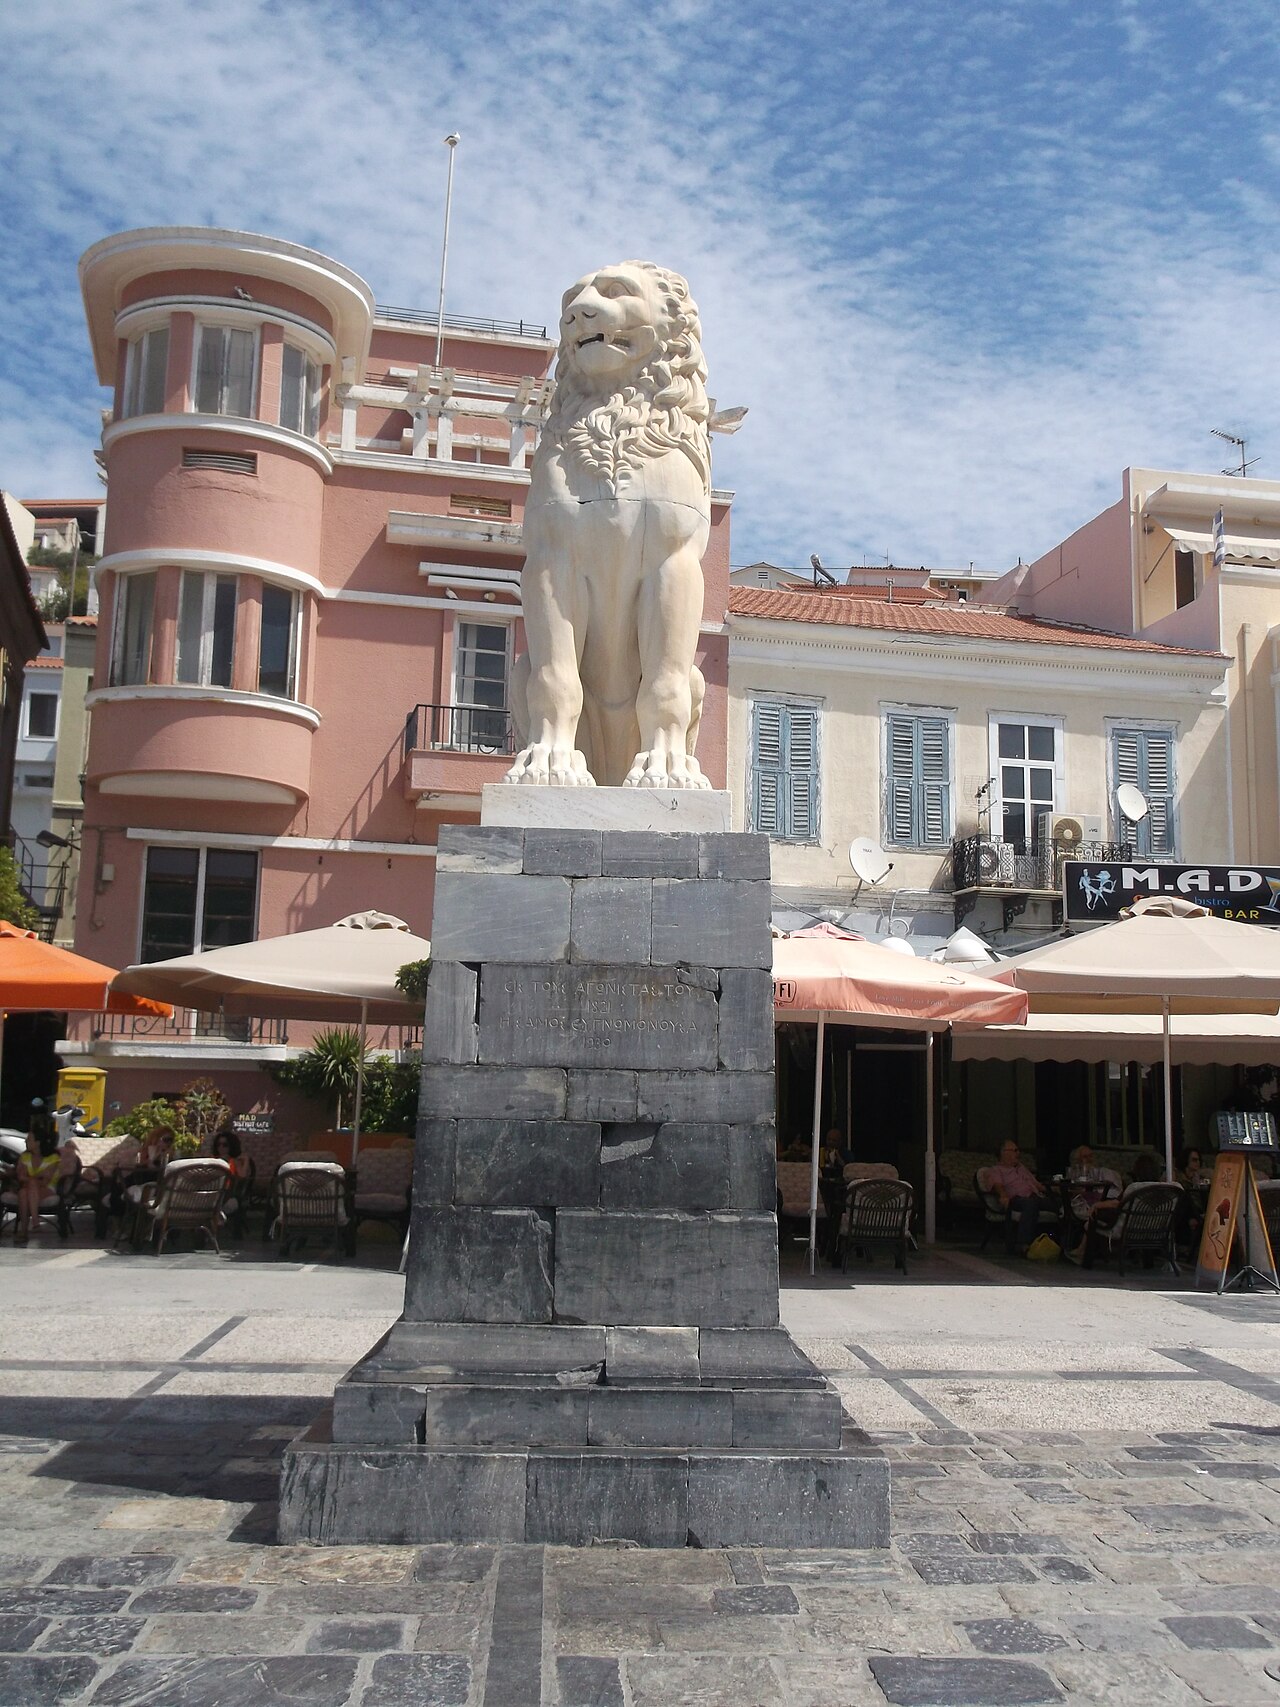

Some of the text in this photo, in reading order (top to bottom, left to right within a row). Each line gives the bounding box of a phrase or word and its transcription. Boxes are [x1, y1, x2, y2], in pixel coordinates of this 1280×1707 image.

[1194, 896, 1230, 906] bistro
[1224, 909, 1260, 919] BAR
[664, 984, 695, 997] ΤΟΥ
[587, 1000, 612, 1013] 1821
